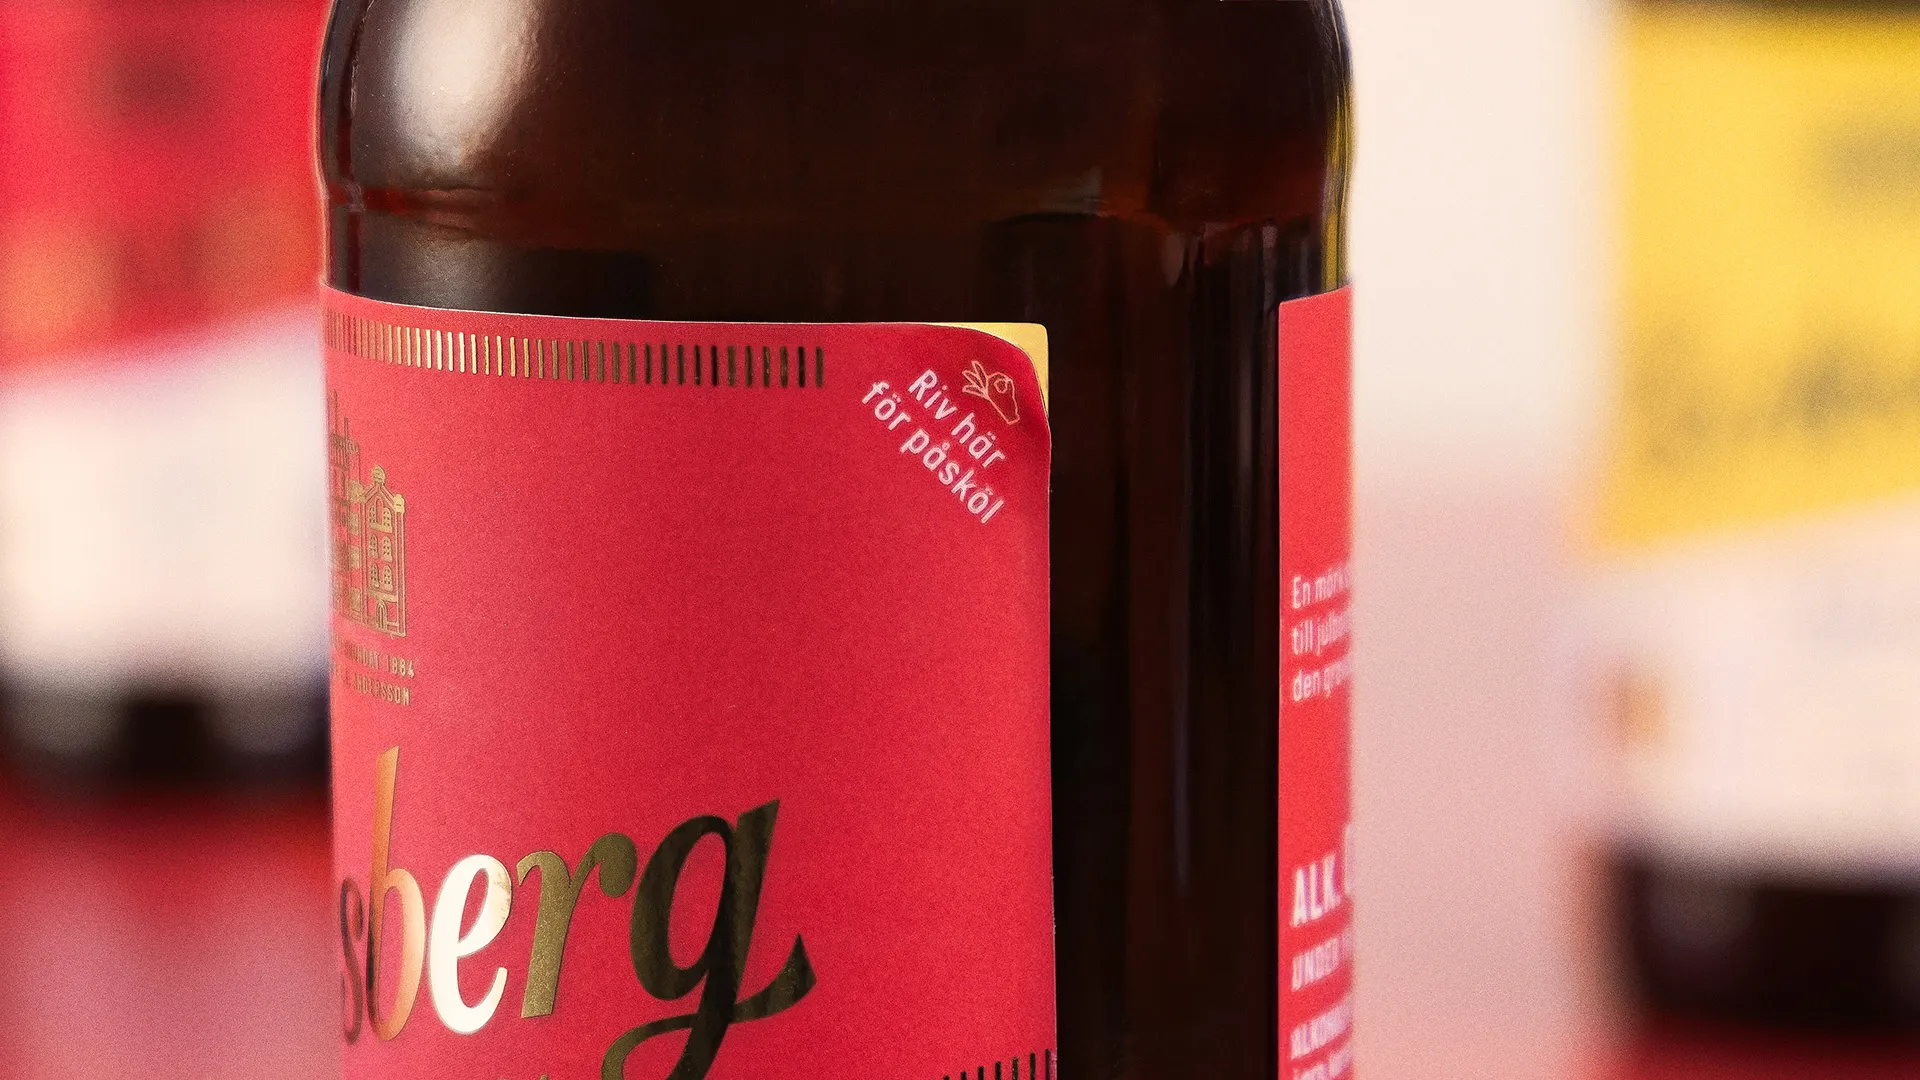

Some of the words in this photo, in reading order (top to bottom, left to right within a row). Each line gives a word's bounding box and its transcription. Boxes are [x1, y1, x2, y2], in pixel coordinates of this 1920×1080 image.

[907, 368, 958, 421] Riv
[950, 412, 1006, 469] här
[861, 380, 912, 432] för
[900, 428, 1005, 525] påsköl
[1293, 576, 1311, 609] En
[1292, 618, 1313, 656] till
[1292, 668, 1320, 701] den
